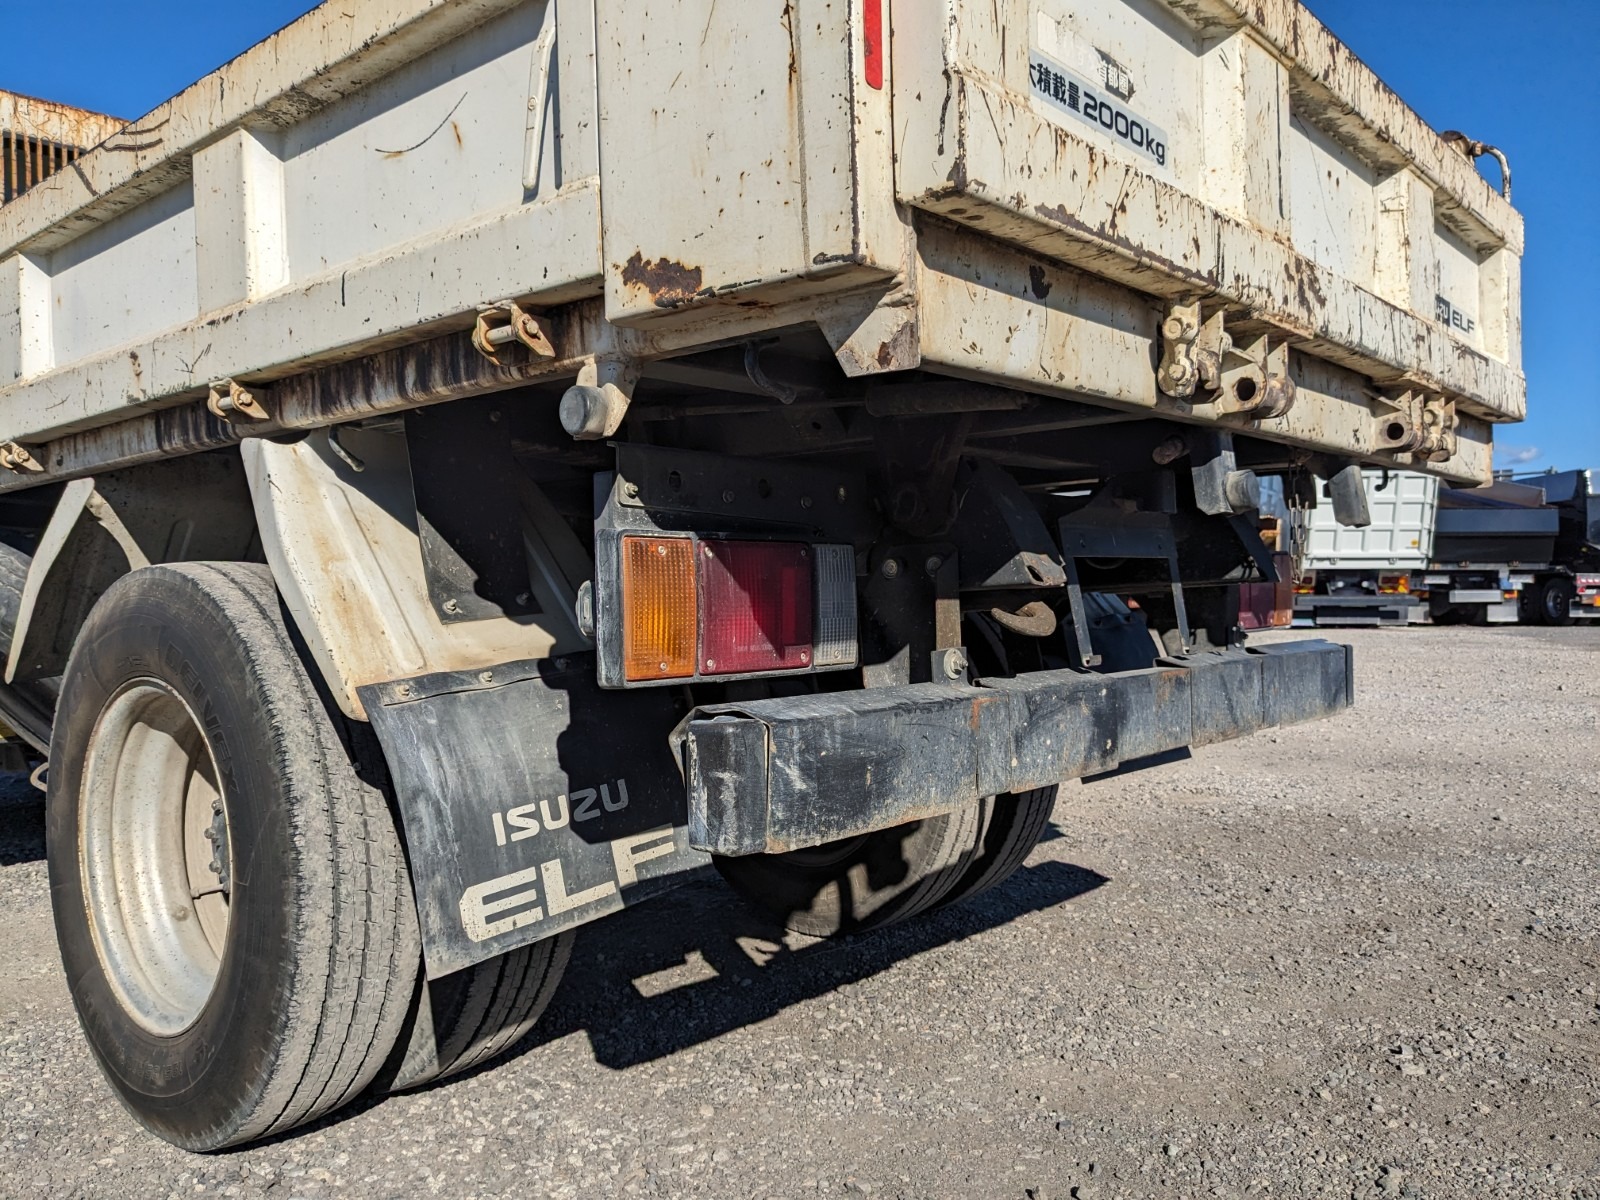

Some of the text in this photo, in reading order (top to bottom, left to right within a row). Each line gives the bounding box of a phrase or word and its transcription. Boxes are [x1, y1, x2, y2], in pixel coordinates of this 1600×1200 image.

[1452, 309, 1475, 334] ELF
[491, 778, 629, 846] ISUZU
[458, 823, 675, 943] ELF
